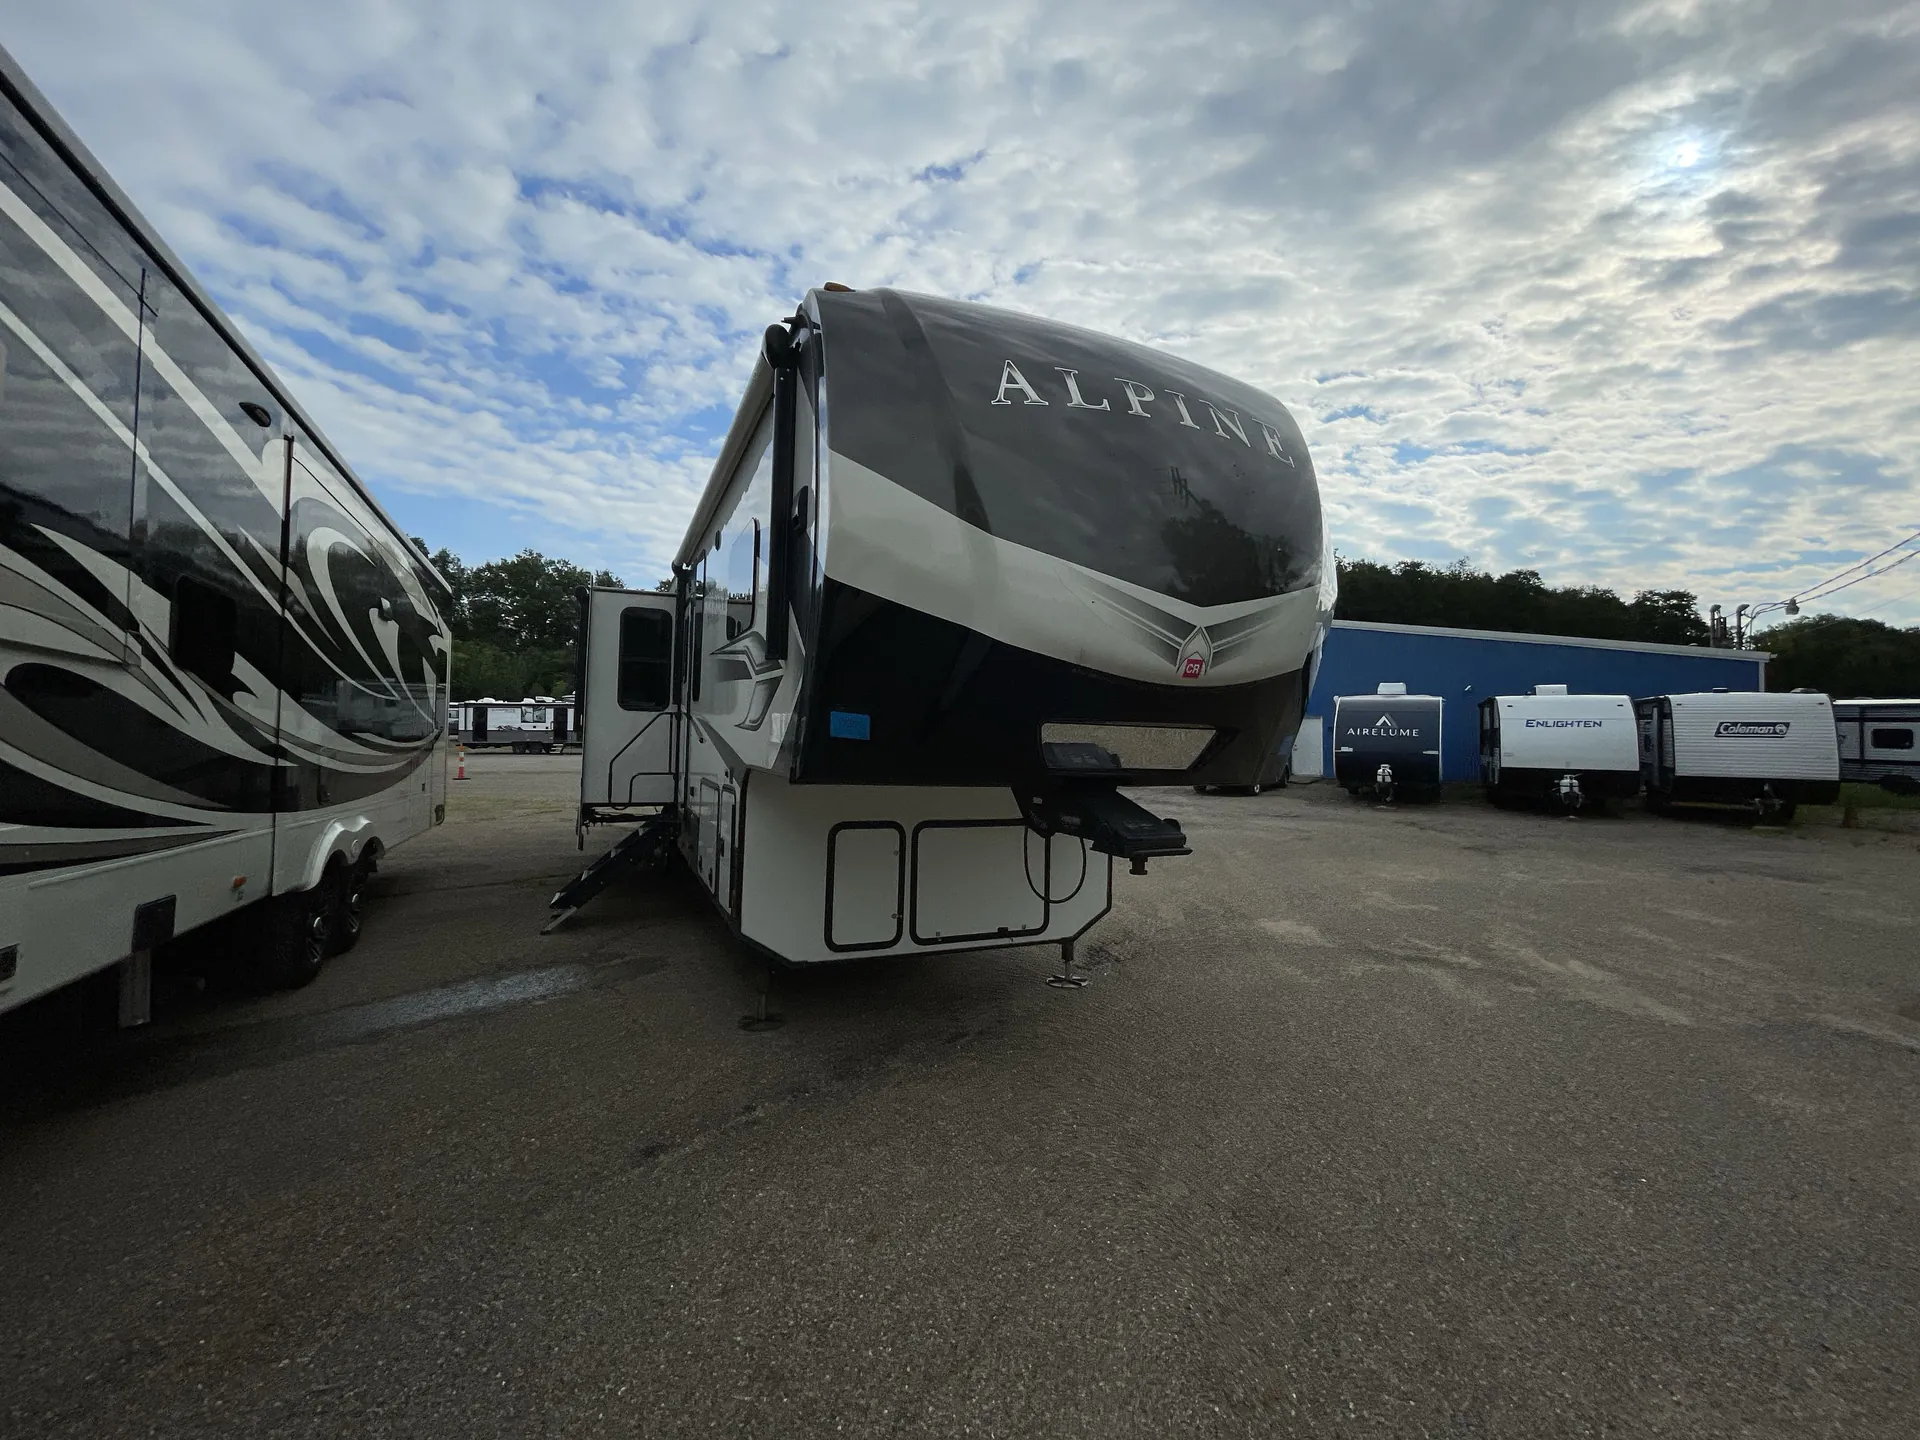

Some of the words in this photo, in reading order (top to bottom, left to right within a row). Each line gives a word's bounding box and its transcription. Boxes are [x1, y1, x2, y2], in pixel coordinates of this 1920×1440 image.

[990, 359, 1295, 469] ALPINE
[1186, 663, 1200, 674] CR
[1525, 719, 1603, 728] ENLIGHTEN
[1719, 722, 1775, 735] Coleman
[1346, 727, 1420, 737] AIRELUME
